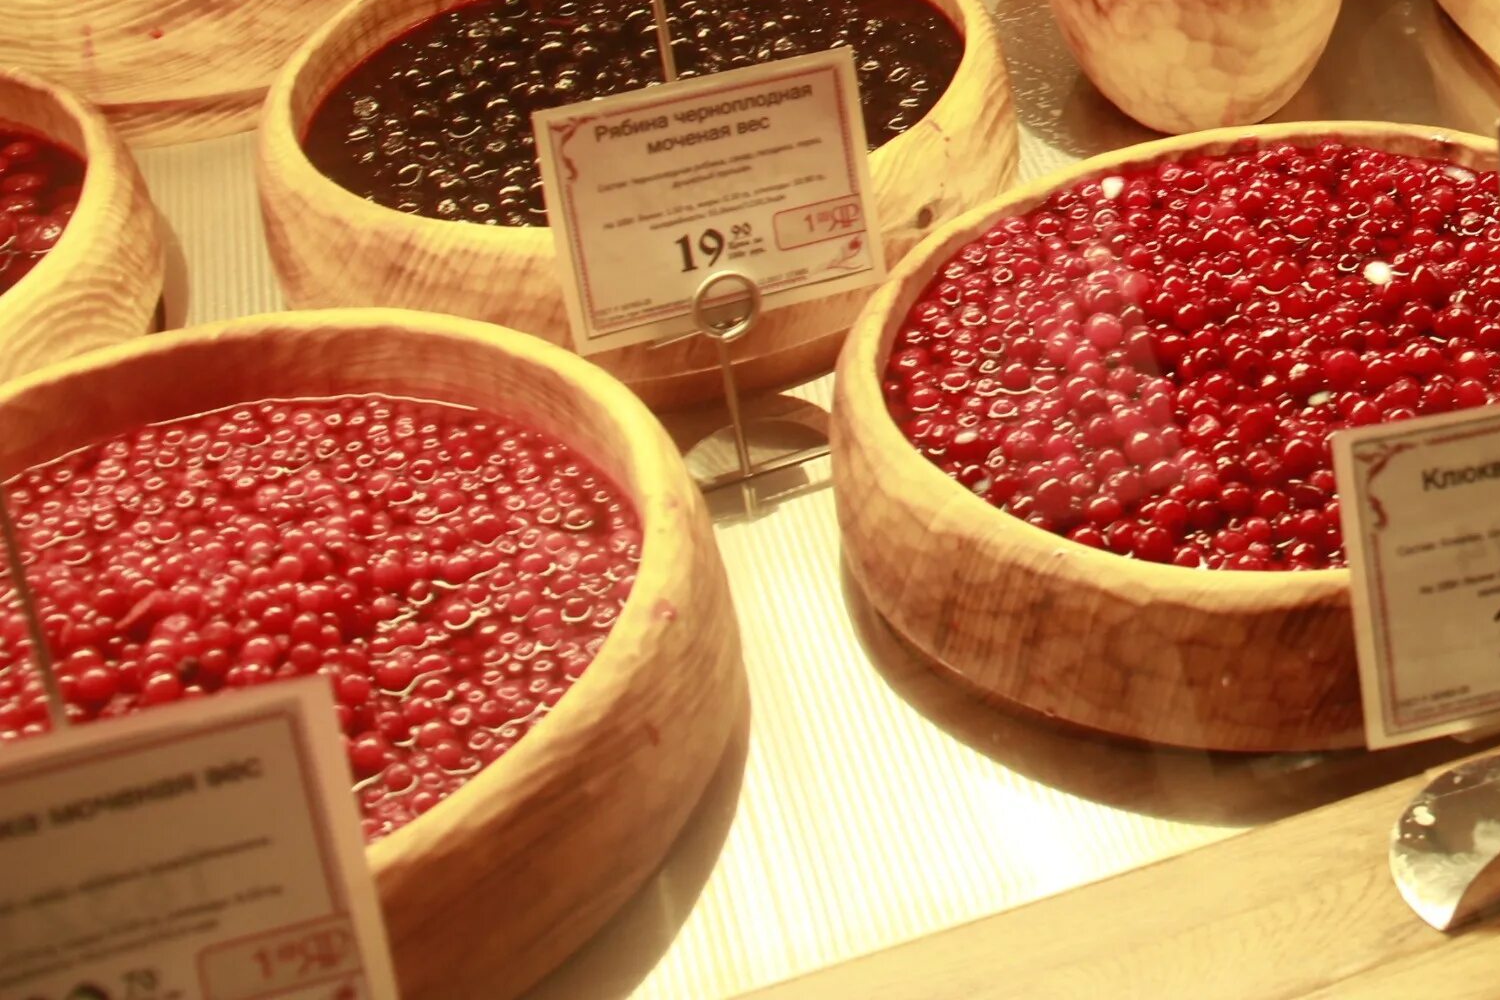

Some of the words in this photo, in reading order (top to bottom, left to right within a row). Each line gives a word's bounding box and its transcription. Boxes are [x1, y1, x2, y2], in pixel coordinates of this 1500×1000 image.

[594, 113, 669, 143] Рябина
[673, 82, 814, 124] черноплодная
[646, 122, 731, 155] моченая
[736, 114, 771, 136] вес
[675, 227, 725, 273] 19
